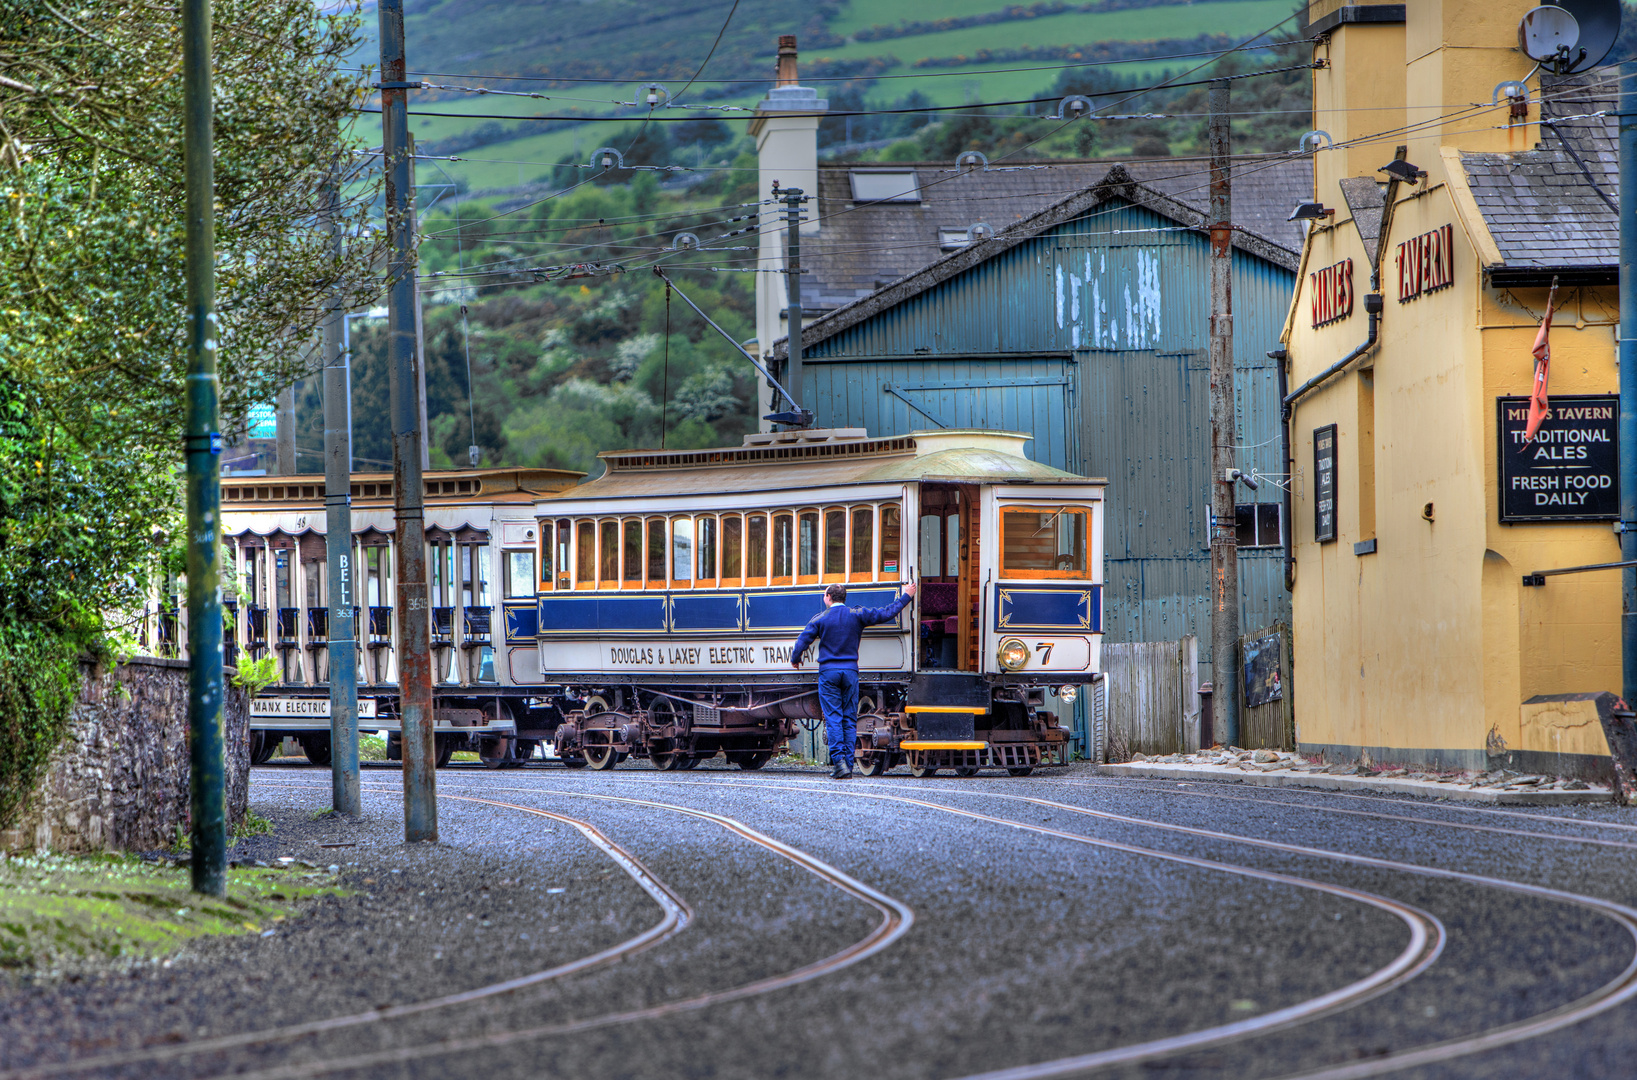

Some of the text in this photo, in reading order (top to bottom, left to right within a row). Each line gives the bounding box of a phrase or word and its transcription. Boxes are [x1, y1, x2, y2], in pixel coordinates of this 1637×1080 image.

[1310, 224, 1454, 329] MINES TAVERN
[1508, 407, 1612, 420] MIS TAVERN
[1534, 446, 1587, 460] ALES
[1512, 475, 1612, 490] FRESH FOOD
[1535, 492, 1589, 505] DAILY
[340, 555, 350, 605] BELL
[611, 647, 653, 664] DOUGLAS
[658, 649, 664, 664] &
[669, 647, 701, 664] LAXEY
[709, 647, 755, 664] ELECTRIC
[1035, 643, 1055, 665] 7
[253, 702, 326, 713] MANX ELECTRIC
